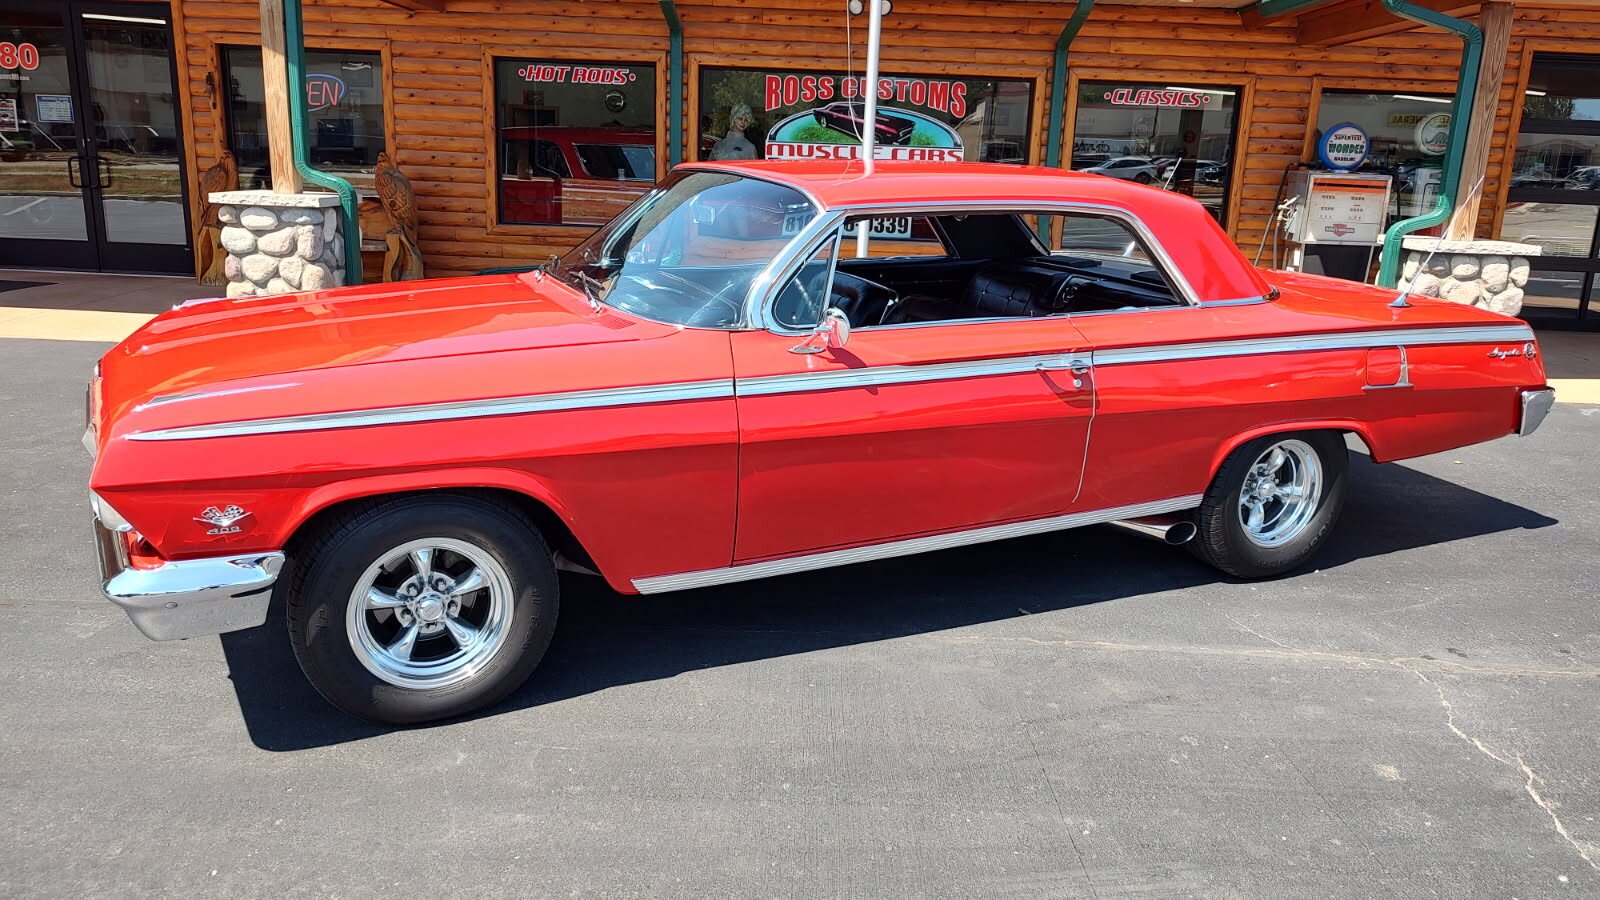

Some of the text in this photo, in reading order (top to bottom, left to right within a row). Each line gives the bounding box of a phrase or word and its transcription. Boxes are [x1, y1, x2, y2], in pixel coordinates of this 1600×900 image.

[525, 65, 629, 85] HOT RODS
[305, 81, 339, 106] EN
[765, 75, 834, 112] ROSS
[1111, 88, 1201, 107] CLASSICS
[891, 147, 963, 162] CARS
[1328, 143, 1364, 155] WONDER
